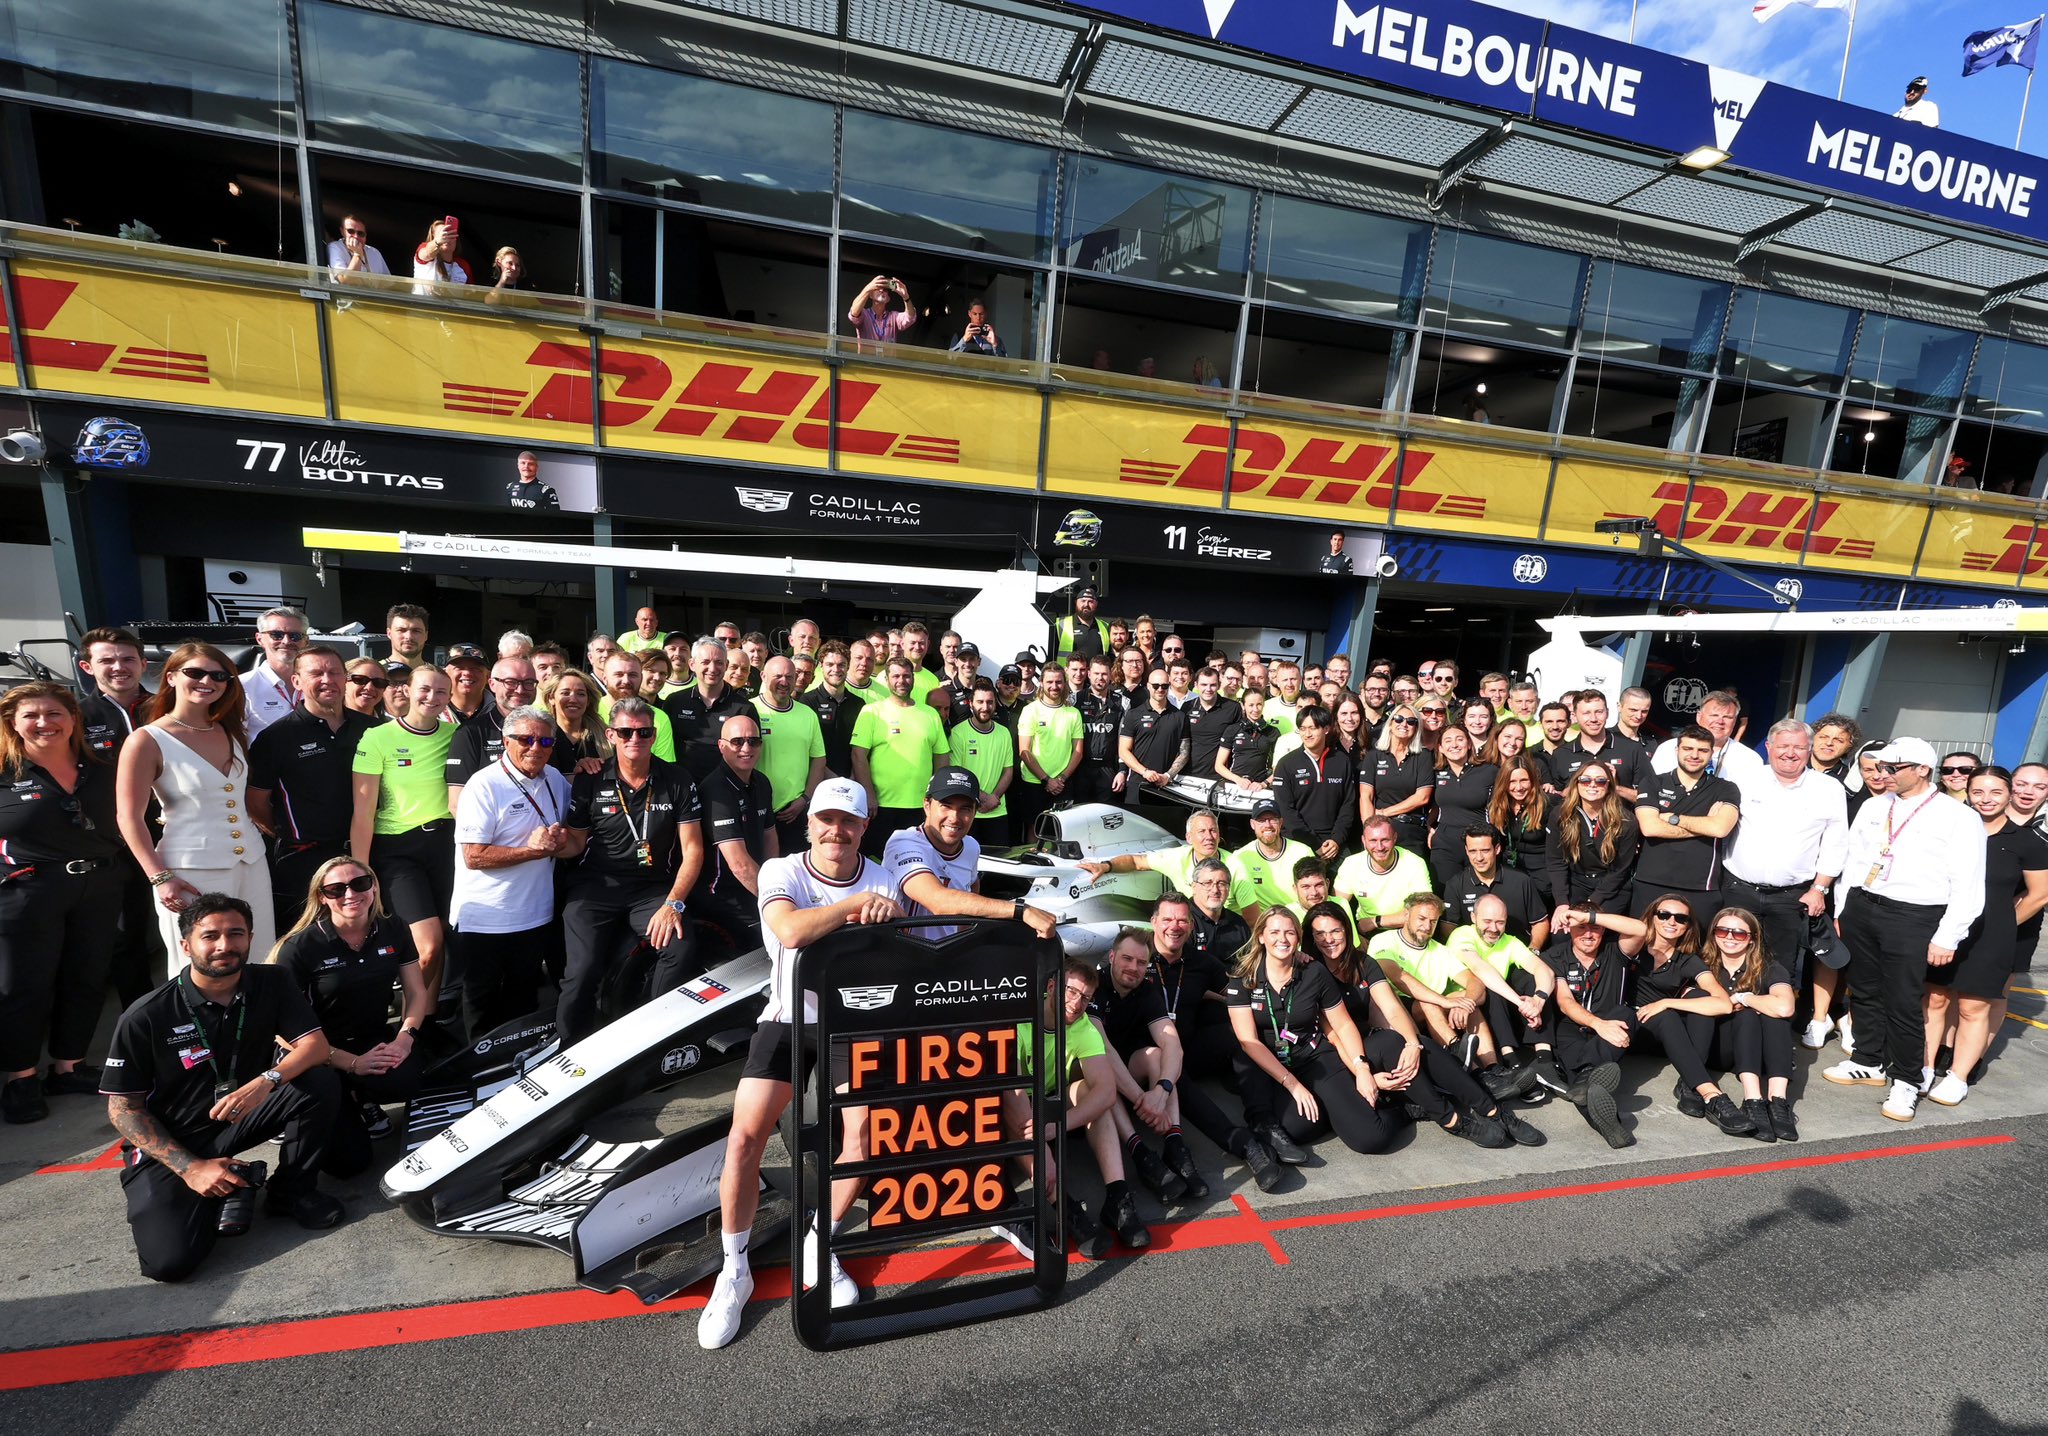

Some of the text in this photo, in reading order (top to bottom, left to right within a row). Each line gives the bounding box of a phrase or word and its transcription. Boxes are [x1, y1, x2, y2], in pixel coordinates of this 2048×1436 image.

[1332, 0, 1643, 117] MELBOURNE
[1711, 96, 1747, 123] MEL
[1806, 119, 2038, 219] MELBOURNE
[521, 341, 899, 456] DHL
[236, 438, 286, 472] 77
[299, 439, 367, 470] Valtteri
[302, 466, 445, 490] BOTTAS
[1172, 423, 1444, 513] DHL
[809, 493, 921, 515] CADILLAC
[809, 509, 872, 522] FORMULA
[885, 515, 920, 526] TEAM
[1648, 481, 1843, 555] DHL
[433, 541, 511, 553] CADILLAC
[516, 548, 558, 556] FORMULA
[1163, 525, 1187, 550] 11
[1197, 526, 1231, 552] Sergio
[1197, 545, 1272, 561] PEREZ
[1852, 616, 1920, 625] CADILLAC
[1080, 878, 1117, 893] CORE SCIENTIFIC
[914, 975, 1027, 995] CADILLAC
[915, 995, 979, 1006] FORMULA
[992, 991, 1027, 1001] TEAM
[493, 1021, 556, 1046] CORE SCIENTI
[852, 1029, 1015, 1090] FIRST
[870, 1096, 1000, 1156] RACE
[441, 1129, 469, 1153] ENNECO
[871, 1164, 1003, 1227] 2026
